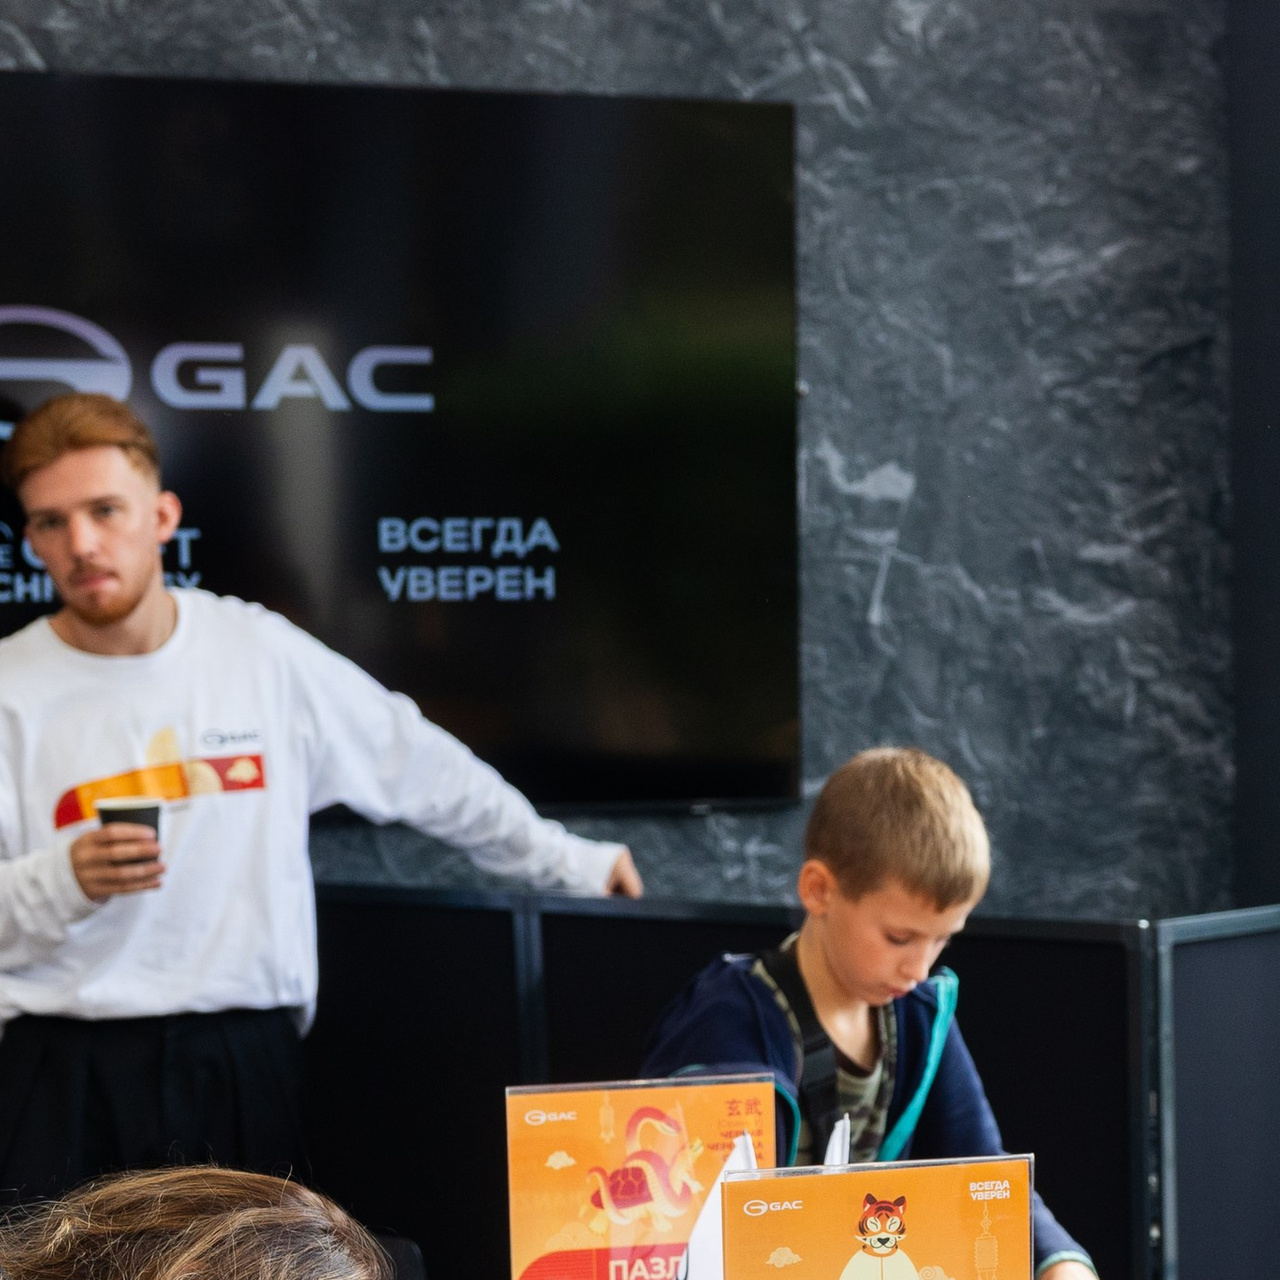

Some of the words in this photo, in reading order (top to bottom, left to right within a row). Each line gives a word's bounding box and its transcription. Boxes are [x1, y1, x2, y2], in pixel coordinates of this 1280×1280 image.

[150, 342, 435, 412] GAC
[378, 517, 560, 558] ВСЕГДА
[377, 566, 556, 601] УВЕРЕН
[546, 1111, 578, 1122] GAC
[969, 1180, 1010, 1191] ВСЕГДА
[970, 1190, 1010, 1201] УВЕРЕН
[769, 1200, 803, 1211] GAC
